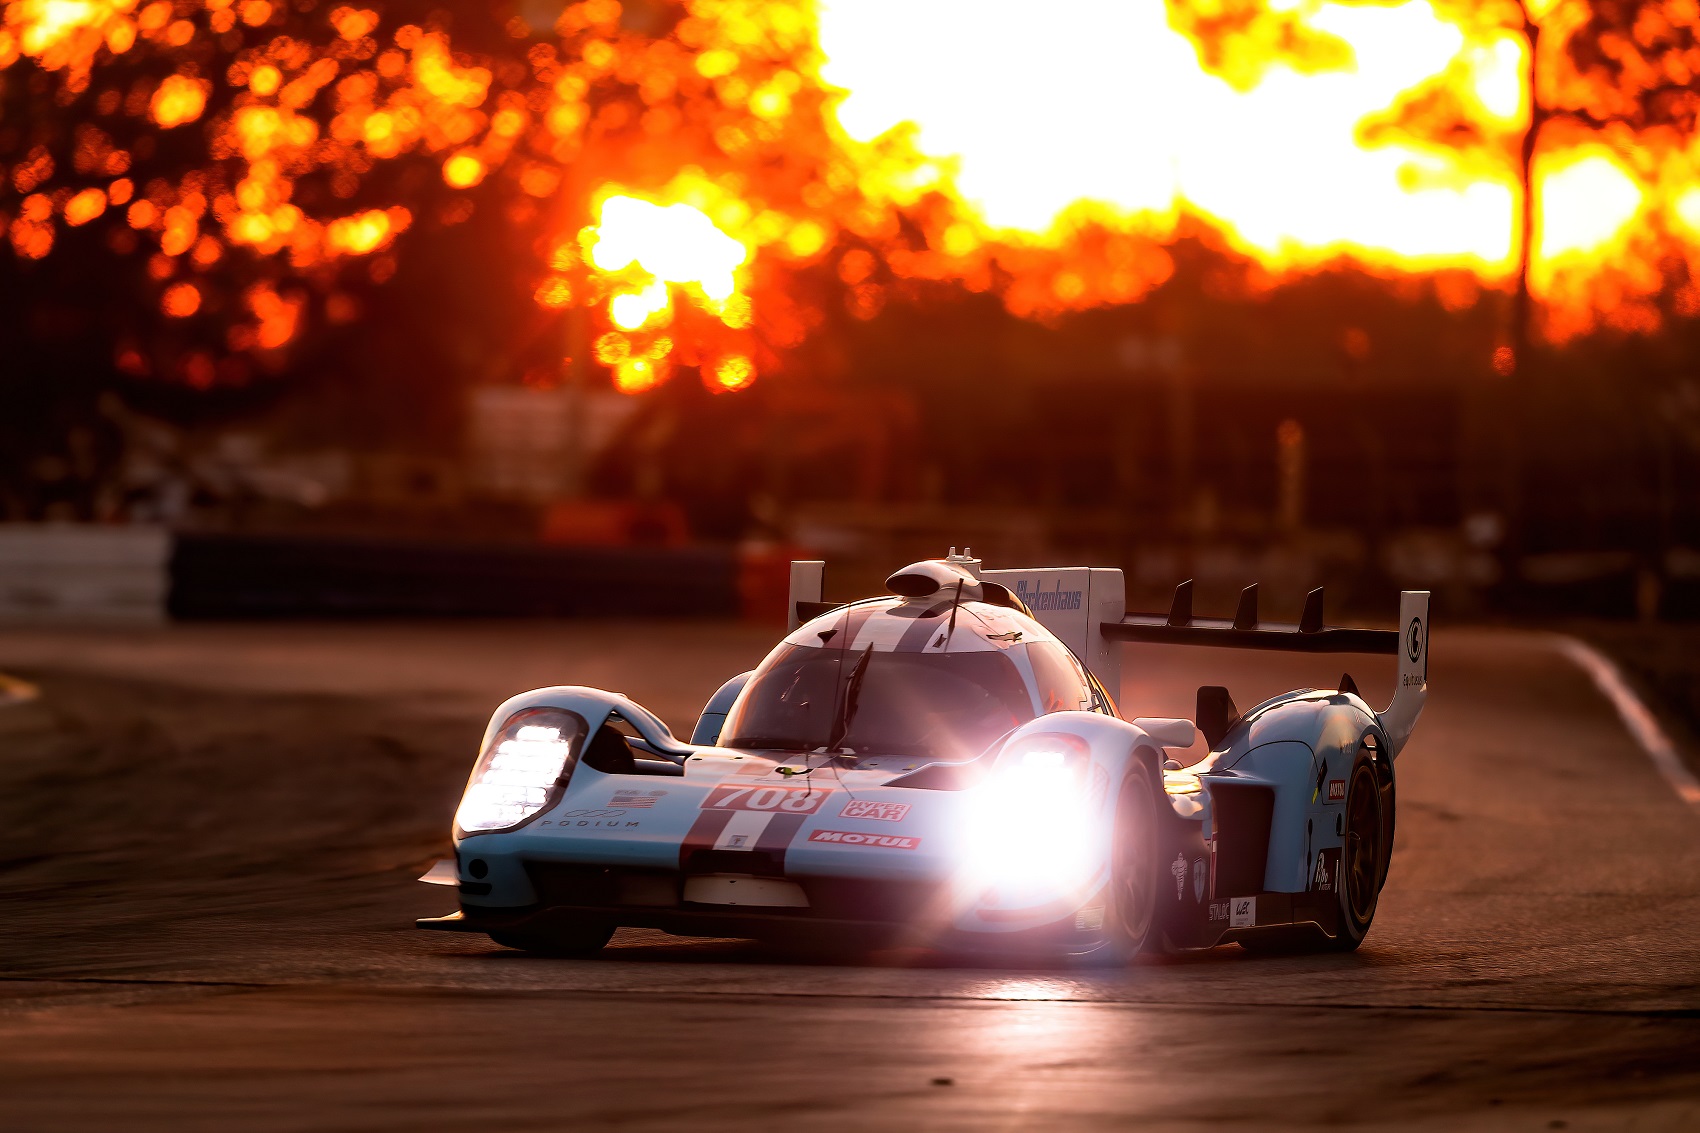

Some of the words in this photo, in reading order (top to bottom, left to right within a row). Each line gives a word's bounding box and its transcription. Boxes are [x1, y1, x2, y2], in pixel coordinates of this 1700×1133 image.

[713, 785, 823, 811] 708
[850, 801, 906, 811] HYPER
[844, 808, 901, 820] CAR
[814, 832, 913, 848] MOTUL
